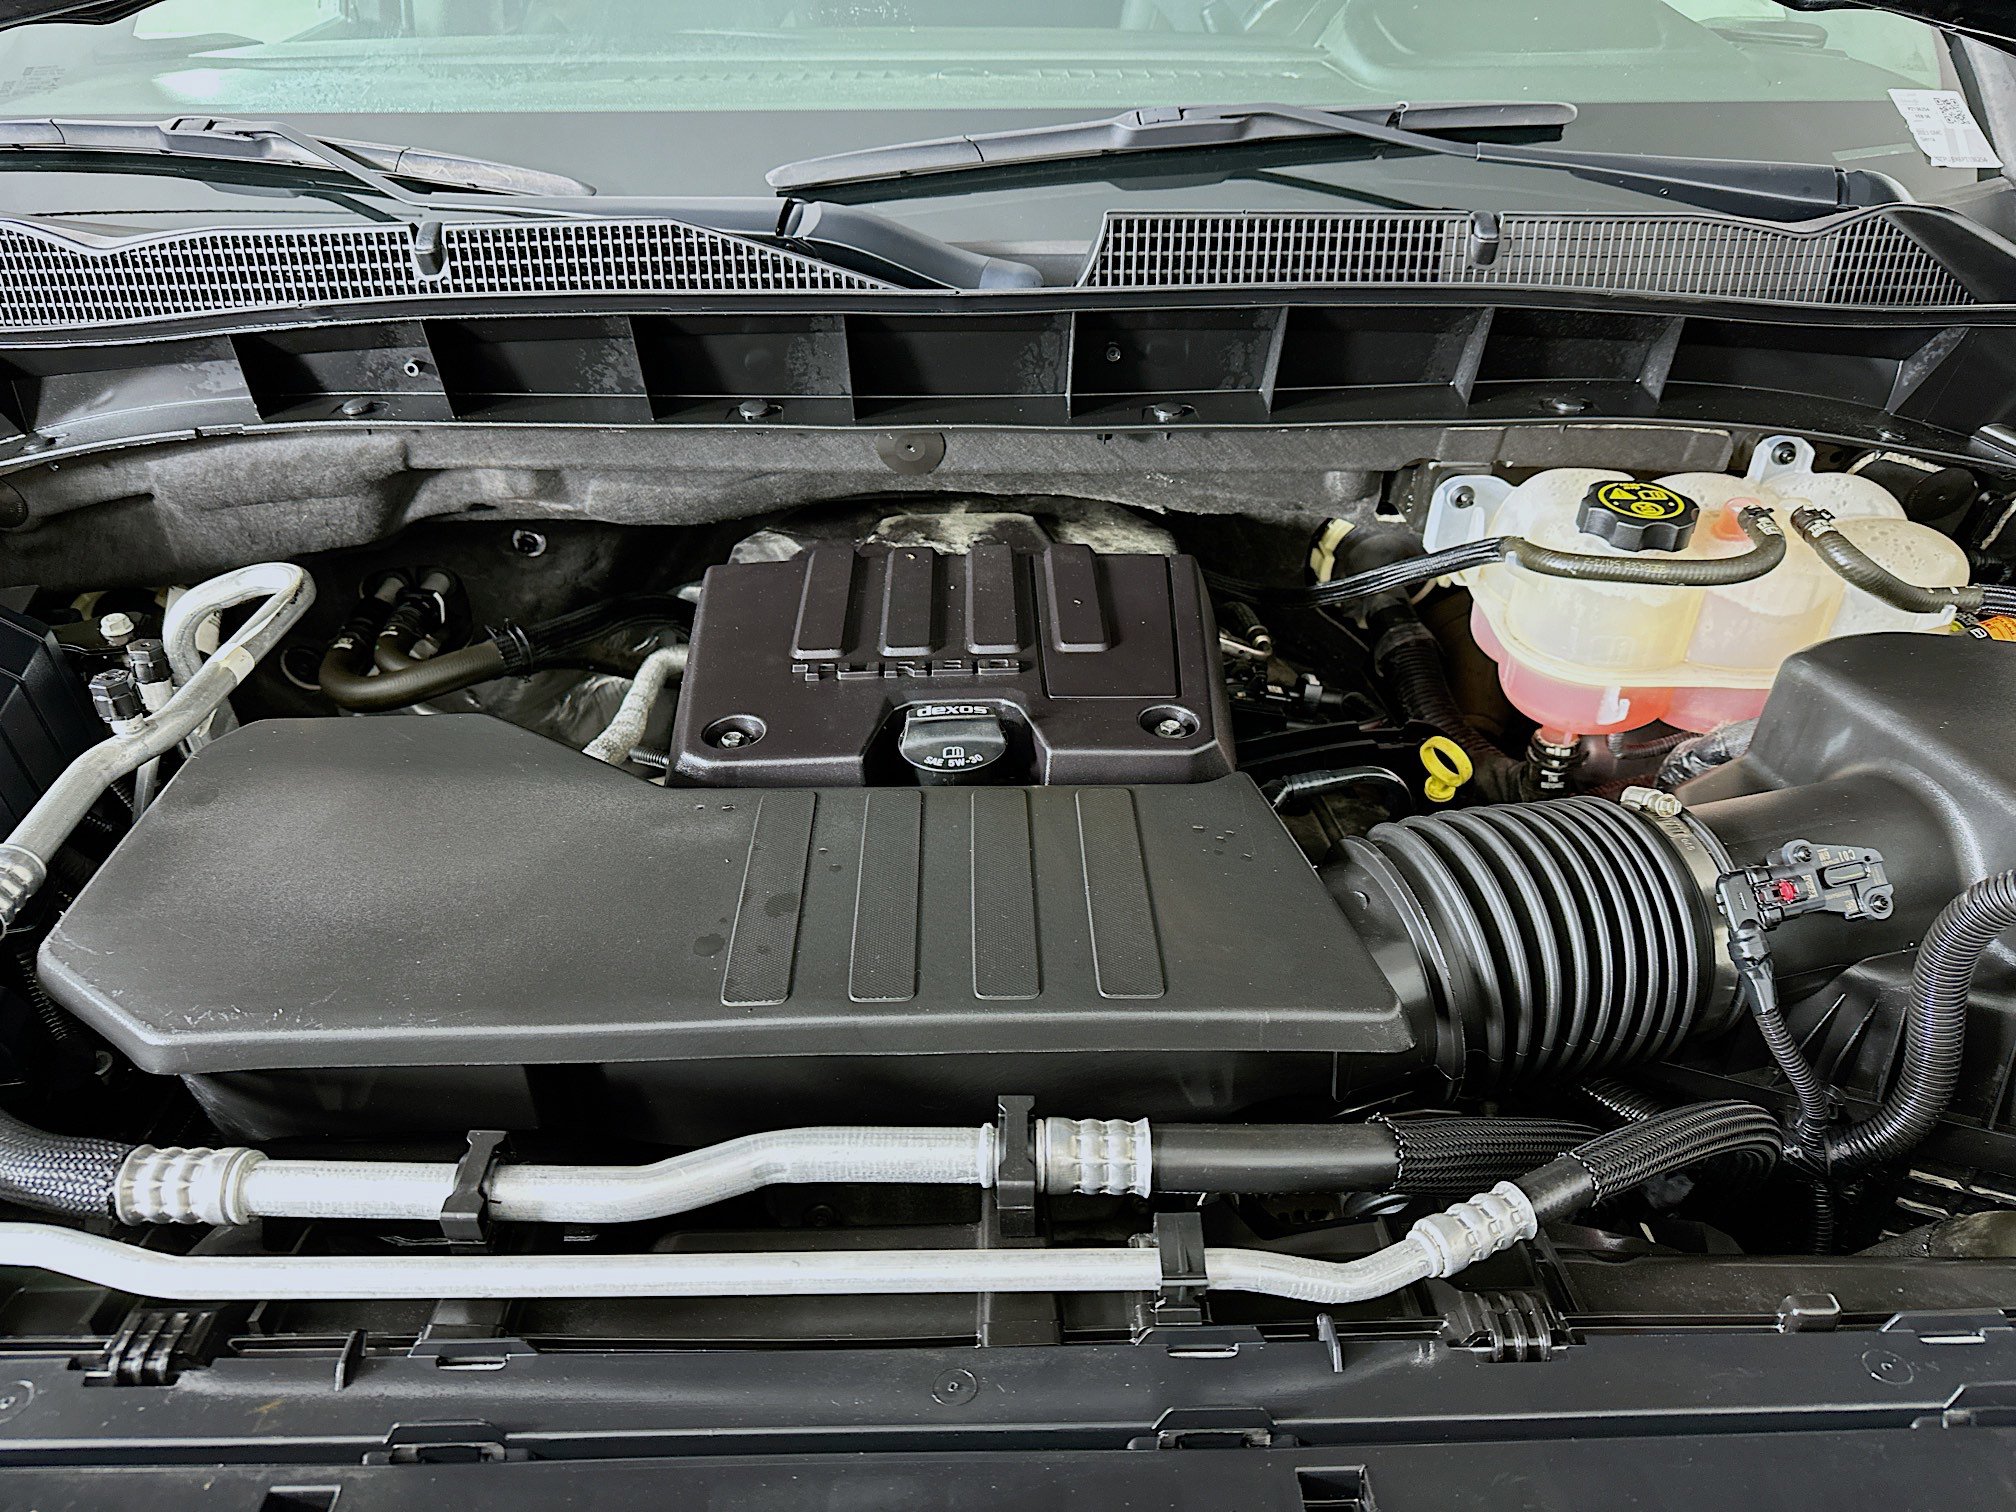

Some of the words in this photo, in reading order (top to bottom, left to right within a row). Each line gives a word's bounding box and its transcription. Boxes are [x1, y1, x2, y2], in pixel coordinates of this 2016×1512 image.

[917, 705, 987, 717] dexos
[923, 755, 945, 767] SAE
[947, 753, 984, 768] 5W-30
